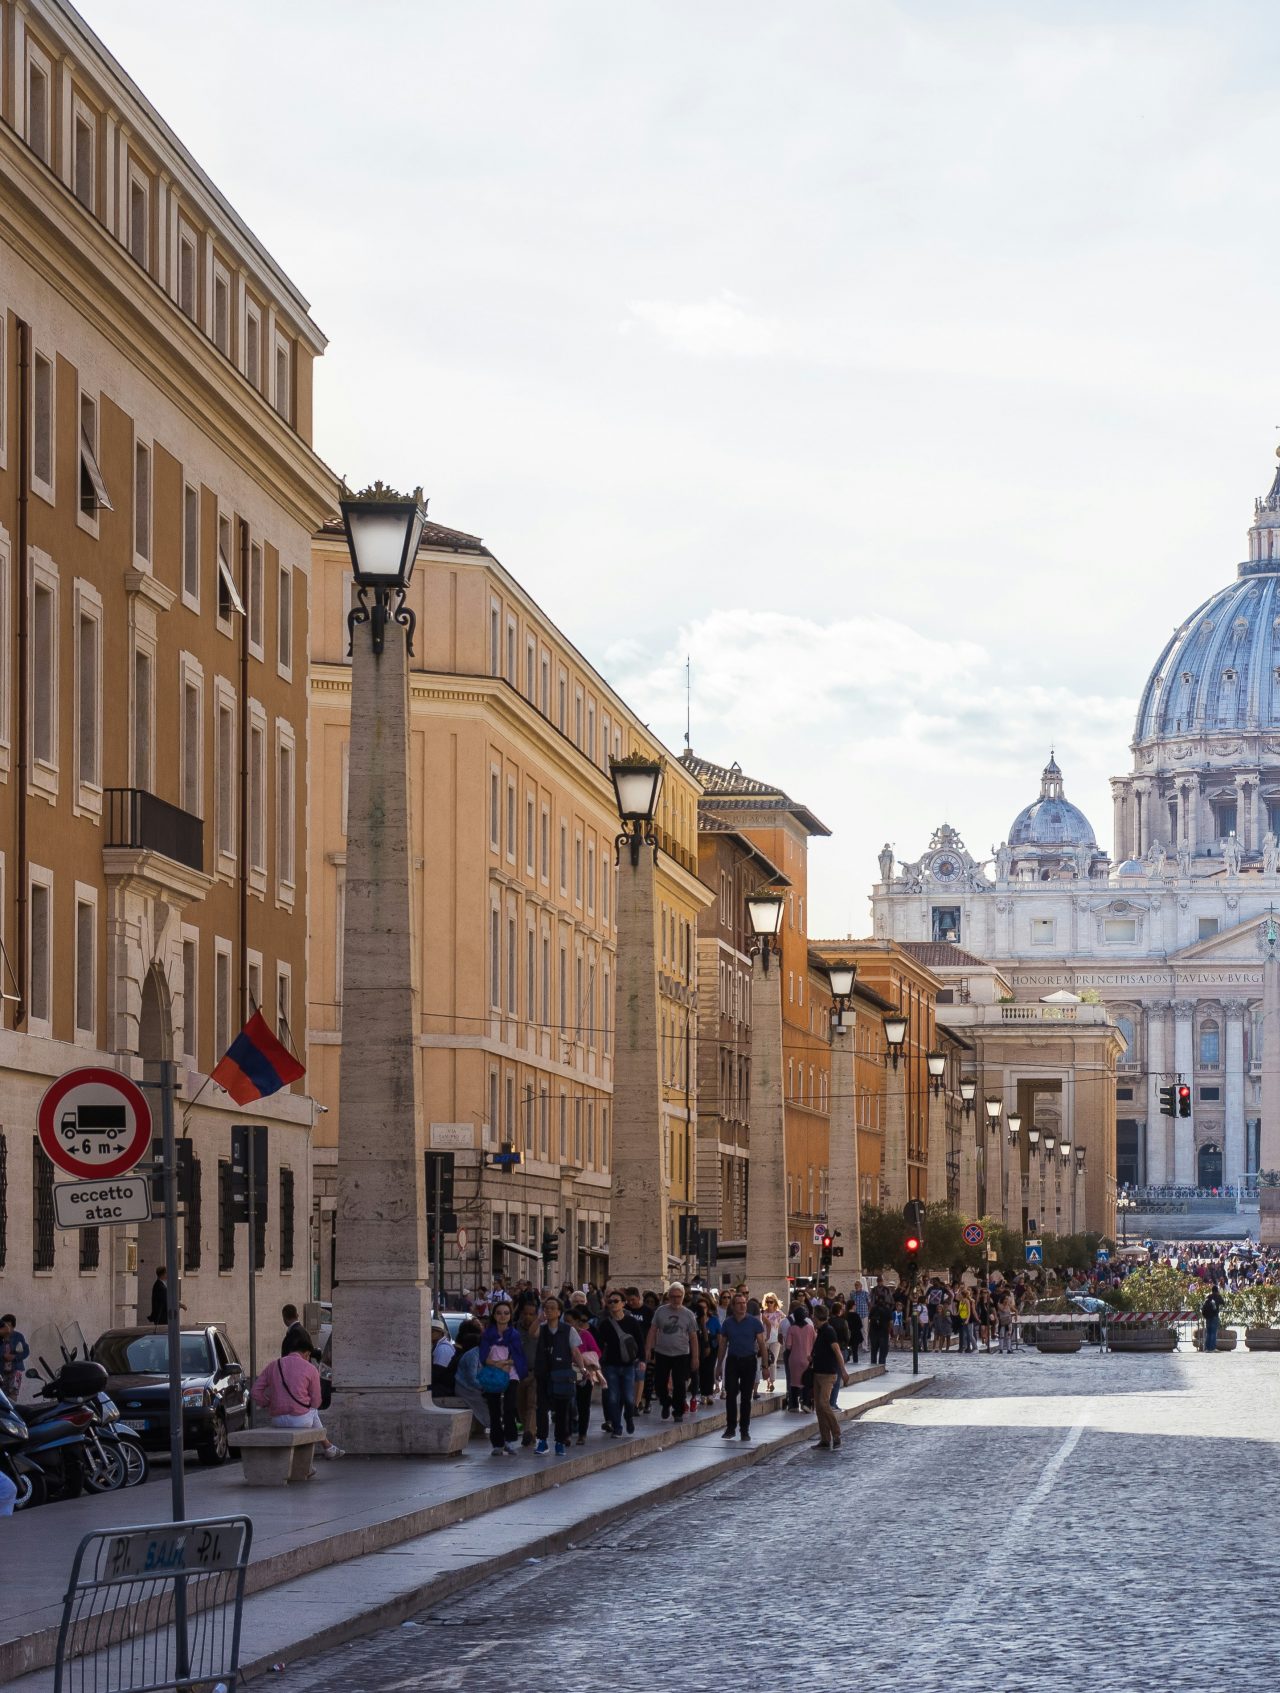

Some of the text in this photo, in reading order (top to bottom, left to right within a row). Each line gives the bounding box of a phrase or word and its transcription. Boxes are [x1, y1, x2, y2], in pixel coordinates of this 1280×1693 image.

[1012, 976, 1072, 985] HONOREM
[1076, 975, 1136, 984] PRINCIPIS
[1177, 974, 1216, 983] PAVLVS
[82, 1139, 110, 1154] 6 m
[70, 1185, 133, 1204] eccetto
[86, 1205, 122, 1220] atac
